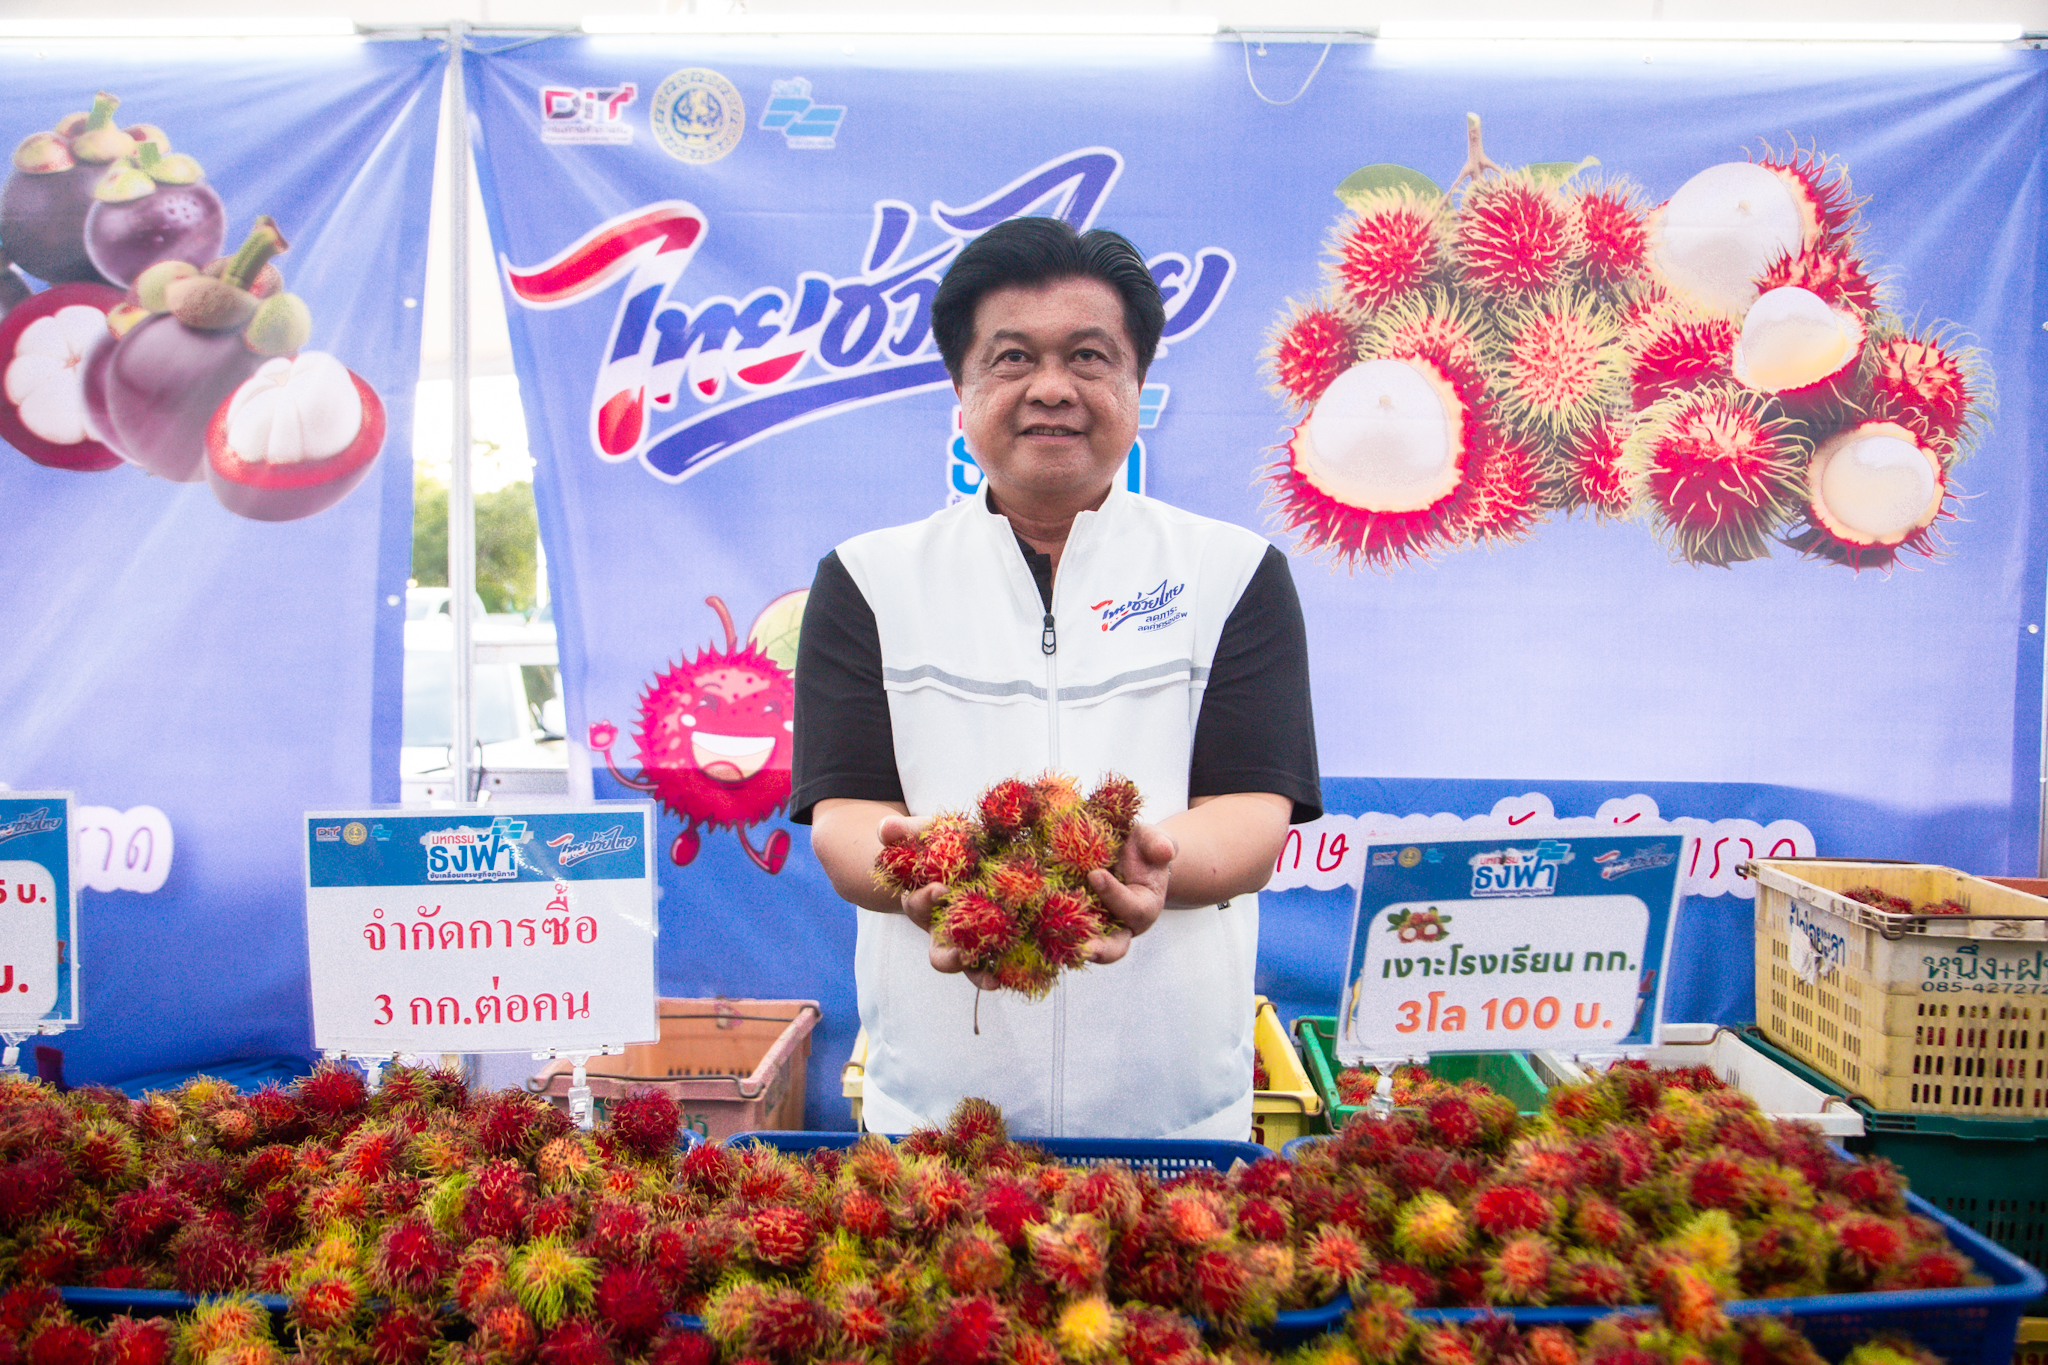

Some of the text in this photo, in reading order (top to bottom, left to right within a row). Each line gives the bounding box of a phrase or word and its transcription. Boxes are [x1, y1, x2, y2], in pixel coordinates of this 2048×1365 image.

[1090, 579, 1185, 632] ไทยช่วยไทย
[1146, 606, 1178, 622] ลดภาระ
[429, 834, 516, 873] ธงฟ้า
[432, 834, 475, 845] มหกรรม
[547, 826, 637, 866] ไทยช่วยไทย
[1475, 855, 1555, 889] ธงฟ้า
[363, 882, 598, 951] จำกัดการซื้อ
[1382, 944, 1637, 978] เงาะโรงเรียน กก.
[374, 976, 590, 1025] 3 กก.ต่อคน
[1395, 991, 1613, 1033] 3โล 100 บ.
